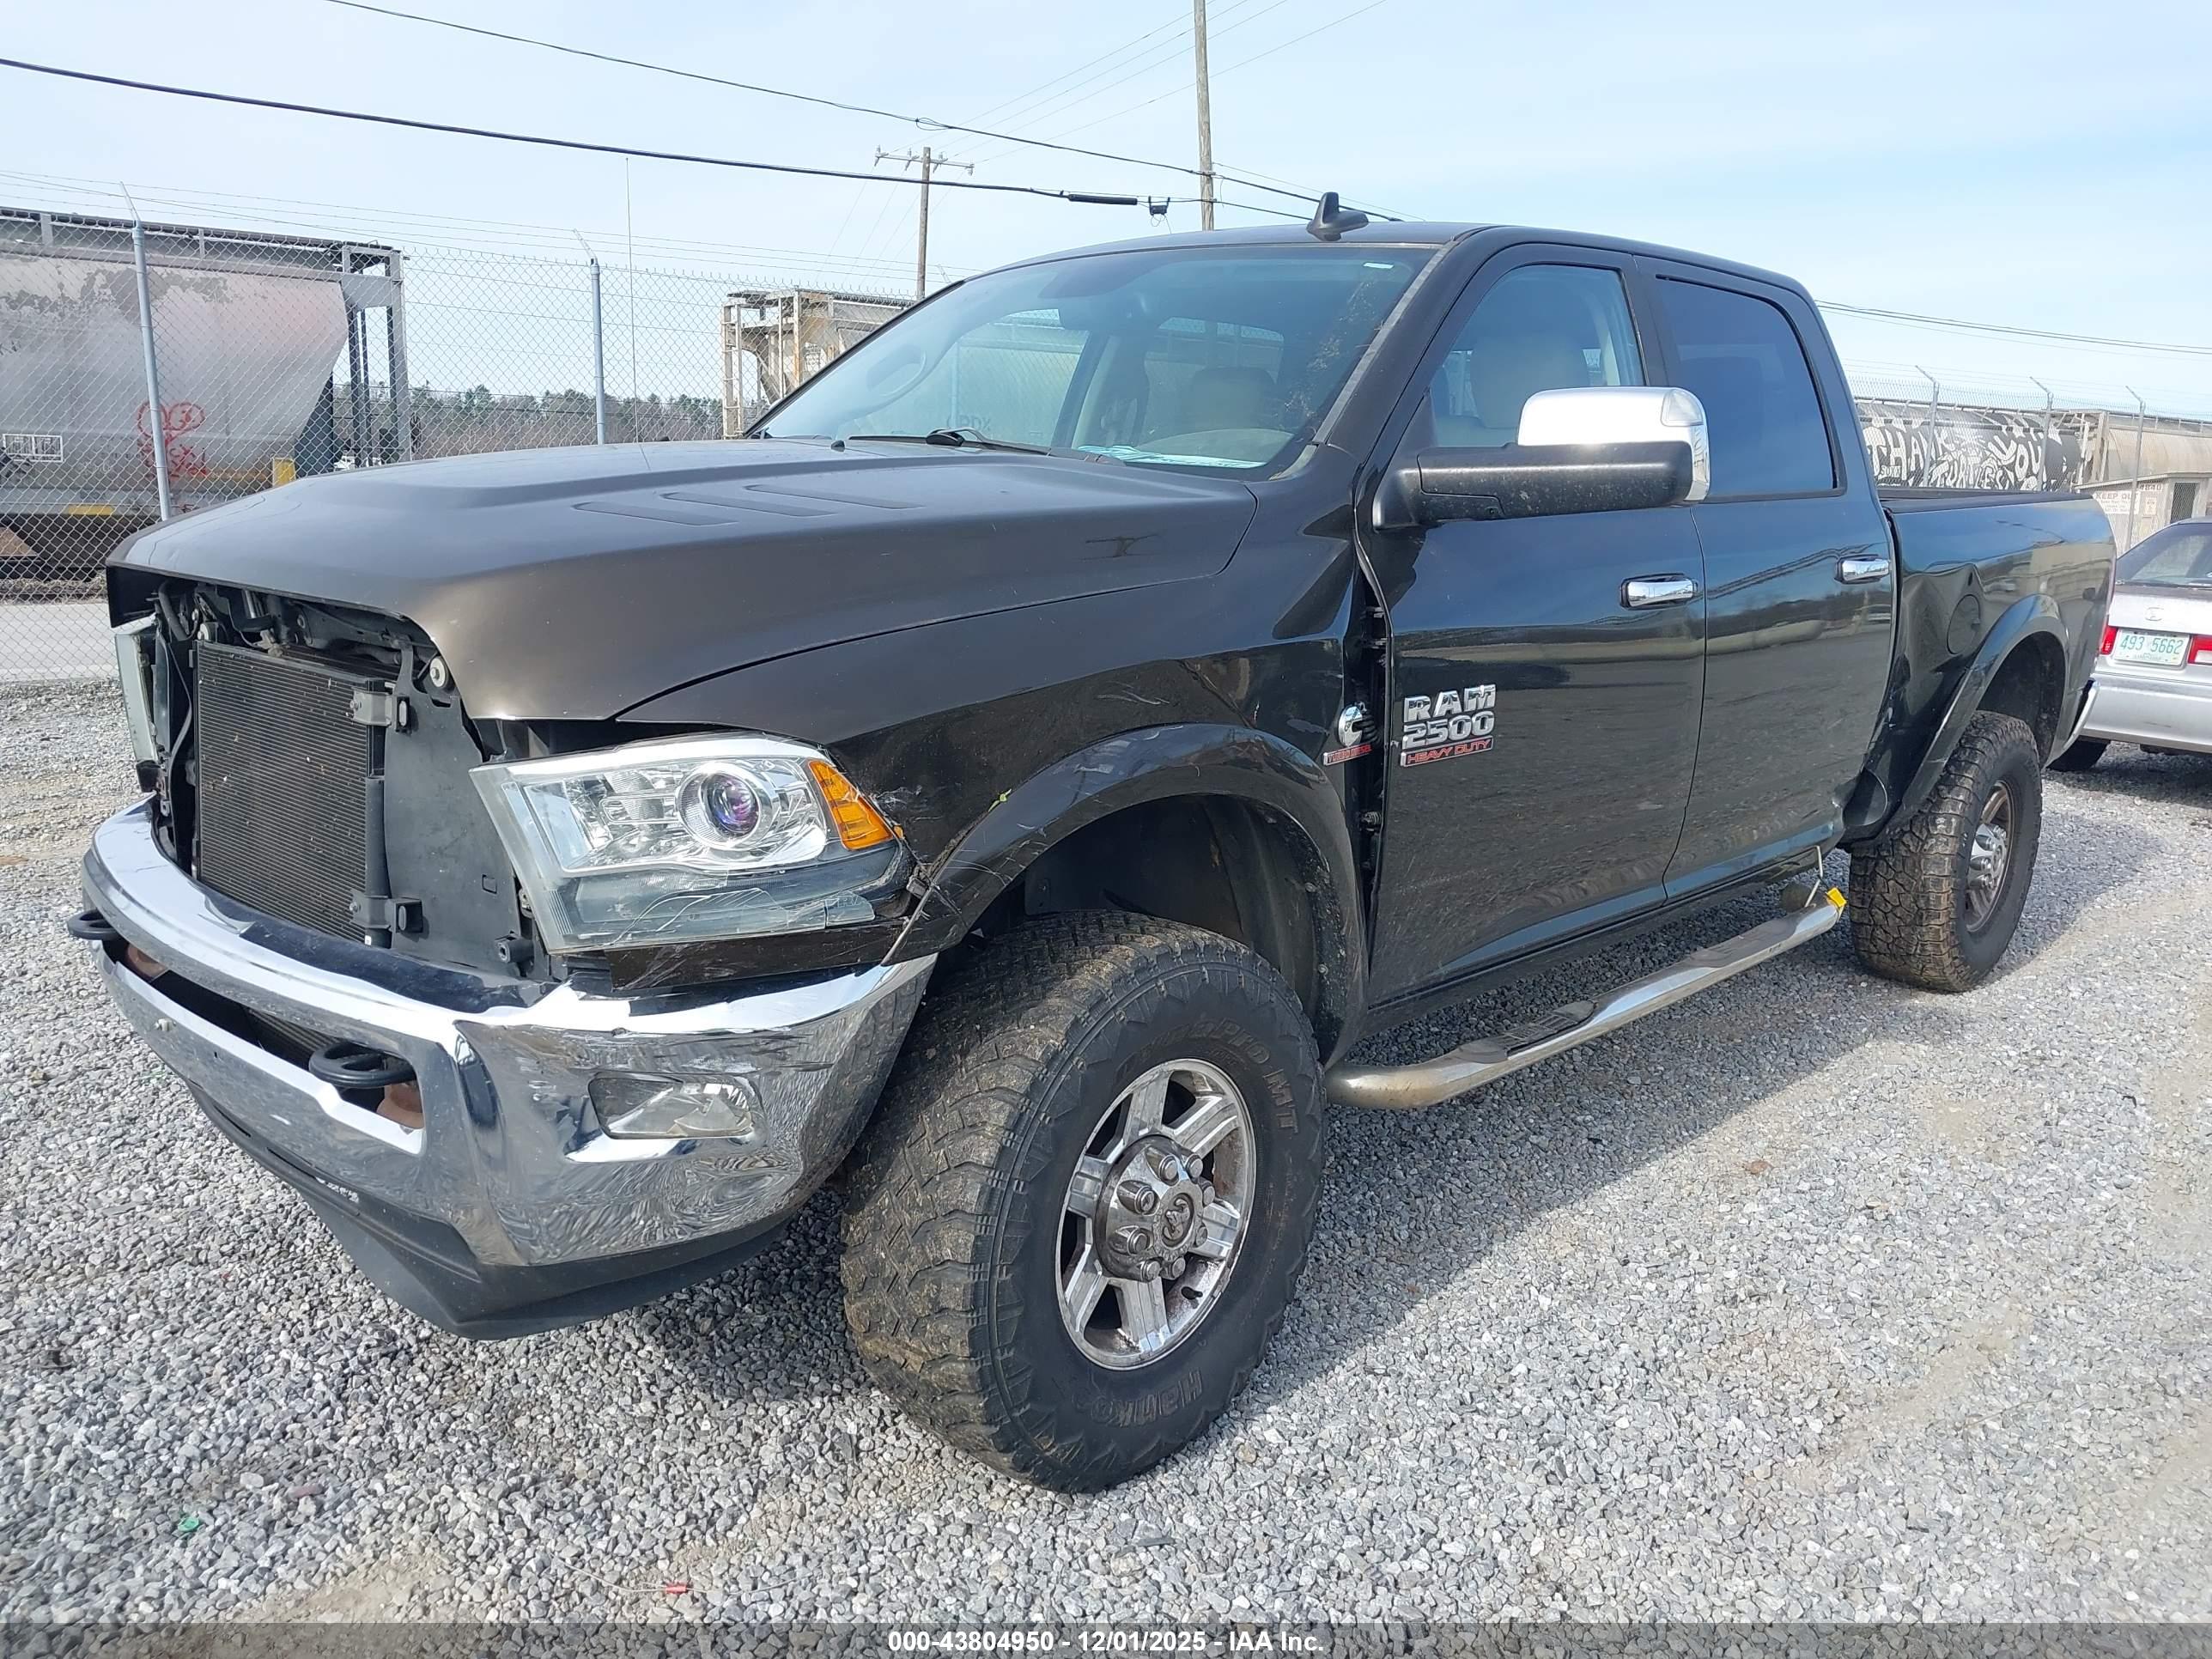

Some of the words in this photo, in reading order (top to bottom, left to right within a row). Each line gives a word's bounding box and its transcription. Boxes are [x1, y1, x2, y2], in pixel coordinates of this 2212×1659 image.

[2118, 635, 2145, 651] 493
[1404, 684, 1497, 723] RAM
[1401, 709, 1495, 751] 2500
[1407, 746, 1455, 764] HEAVY
[1454, 738, 1492, 756] DUTY
